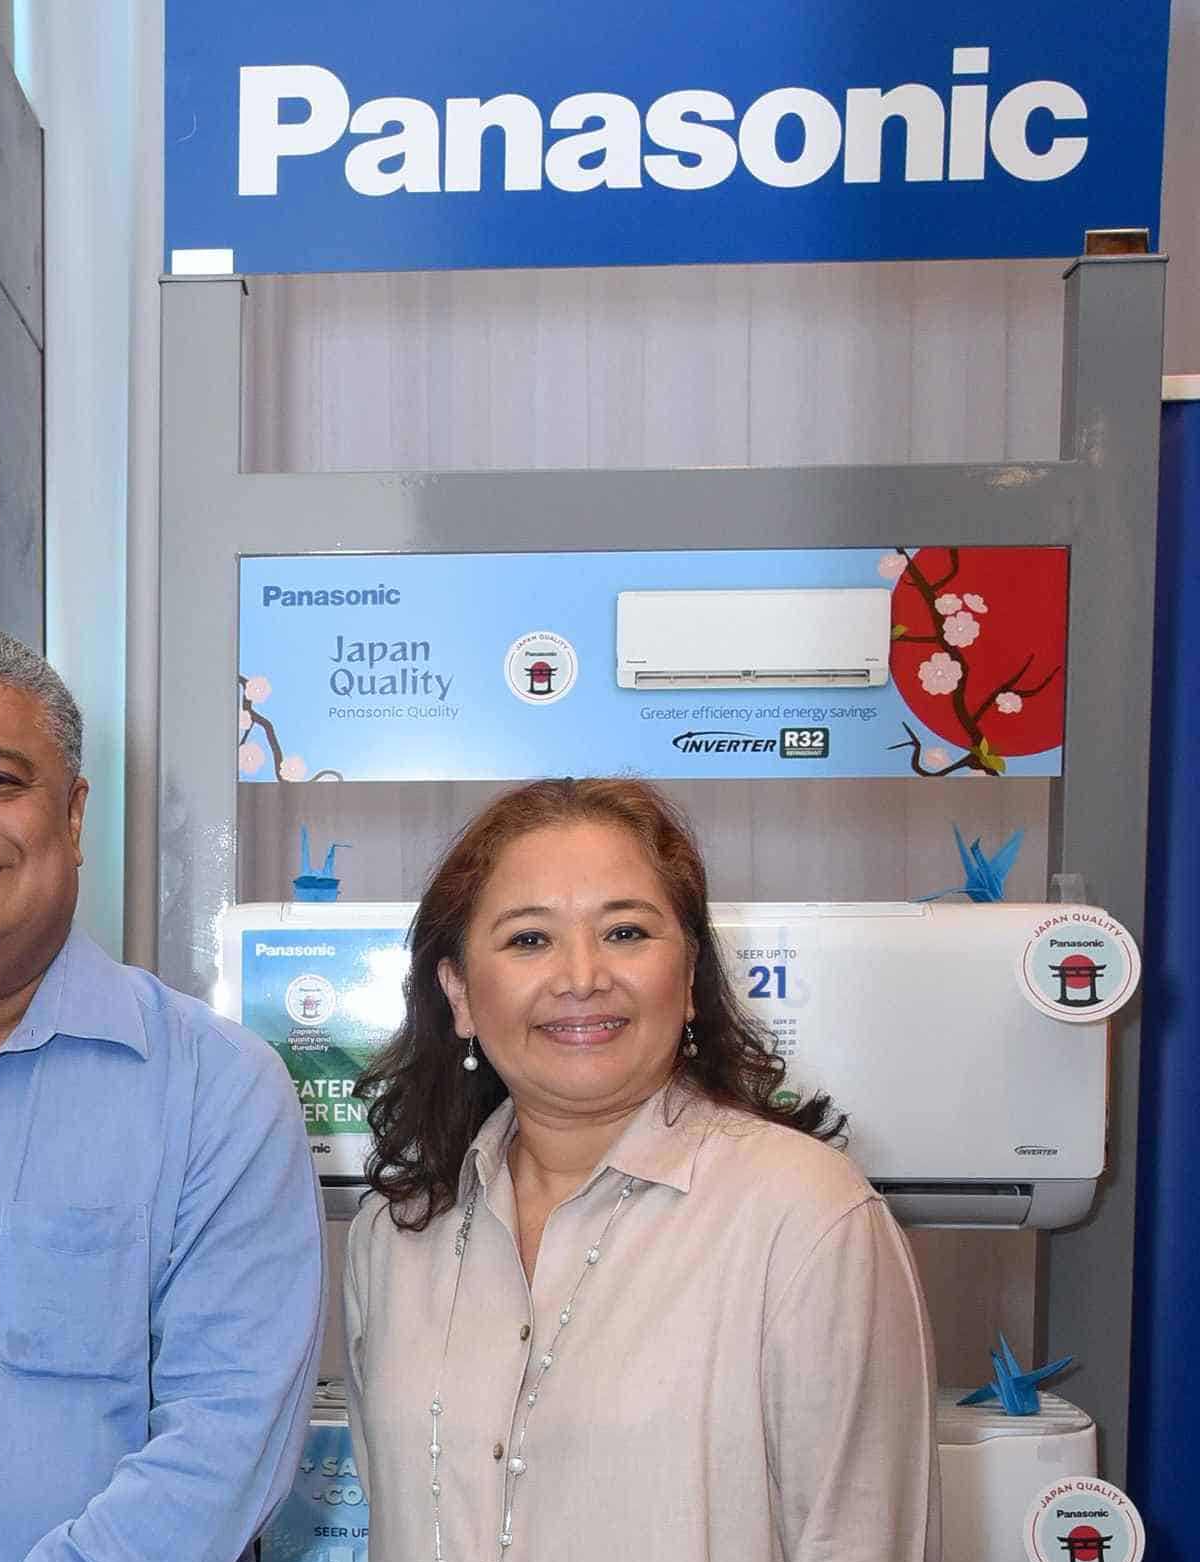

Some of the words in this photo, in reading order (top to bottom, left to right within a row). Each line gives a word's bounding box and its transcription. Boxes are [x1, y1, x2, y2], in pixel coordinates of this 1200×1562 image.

[238, 47, 1088, 197] Panasonic
[262, 584, 401, 608] Panasonic
[329, 636, 431, 669] Japan
[329, 668, 454, 701] Quality
[328, 706, 403, 719] Panasonic
[407, 705, 460, 721] Quality
[640, 706, 690, 719] Greater
[692, 705, 752, 722] efficiency
[754, 705, 780, 719] and
[782, 707, 828, 722] energy
[830, 705, 878, 722] savings
[681, 731, 777, 753] INVERTER
[783, 731, 825, 748] R32
[1033, 913, 1068, 939] JAPAN
[1071, 912, 1123, 938] QUALITY
[255, 942, 337, 957] Panasonic
[736, 949, 765, 960] SEER
[766, 949, 781, 959] UP
[783, 949, 797, 959] TO
[1049, 939, 1105, 948] Panasonic
[747, 965, 786, 998] 21
[1040, 1482, 1073, 1509] JAPAN
[1076, 1481, 1127, 1506] QUALITY
[1056, 1508, 1110, 1519] Panasonic
[314, 1526, 348, 1538] SEER
